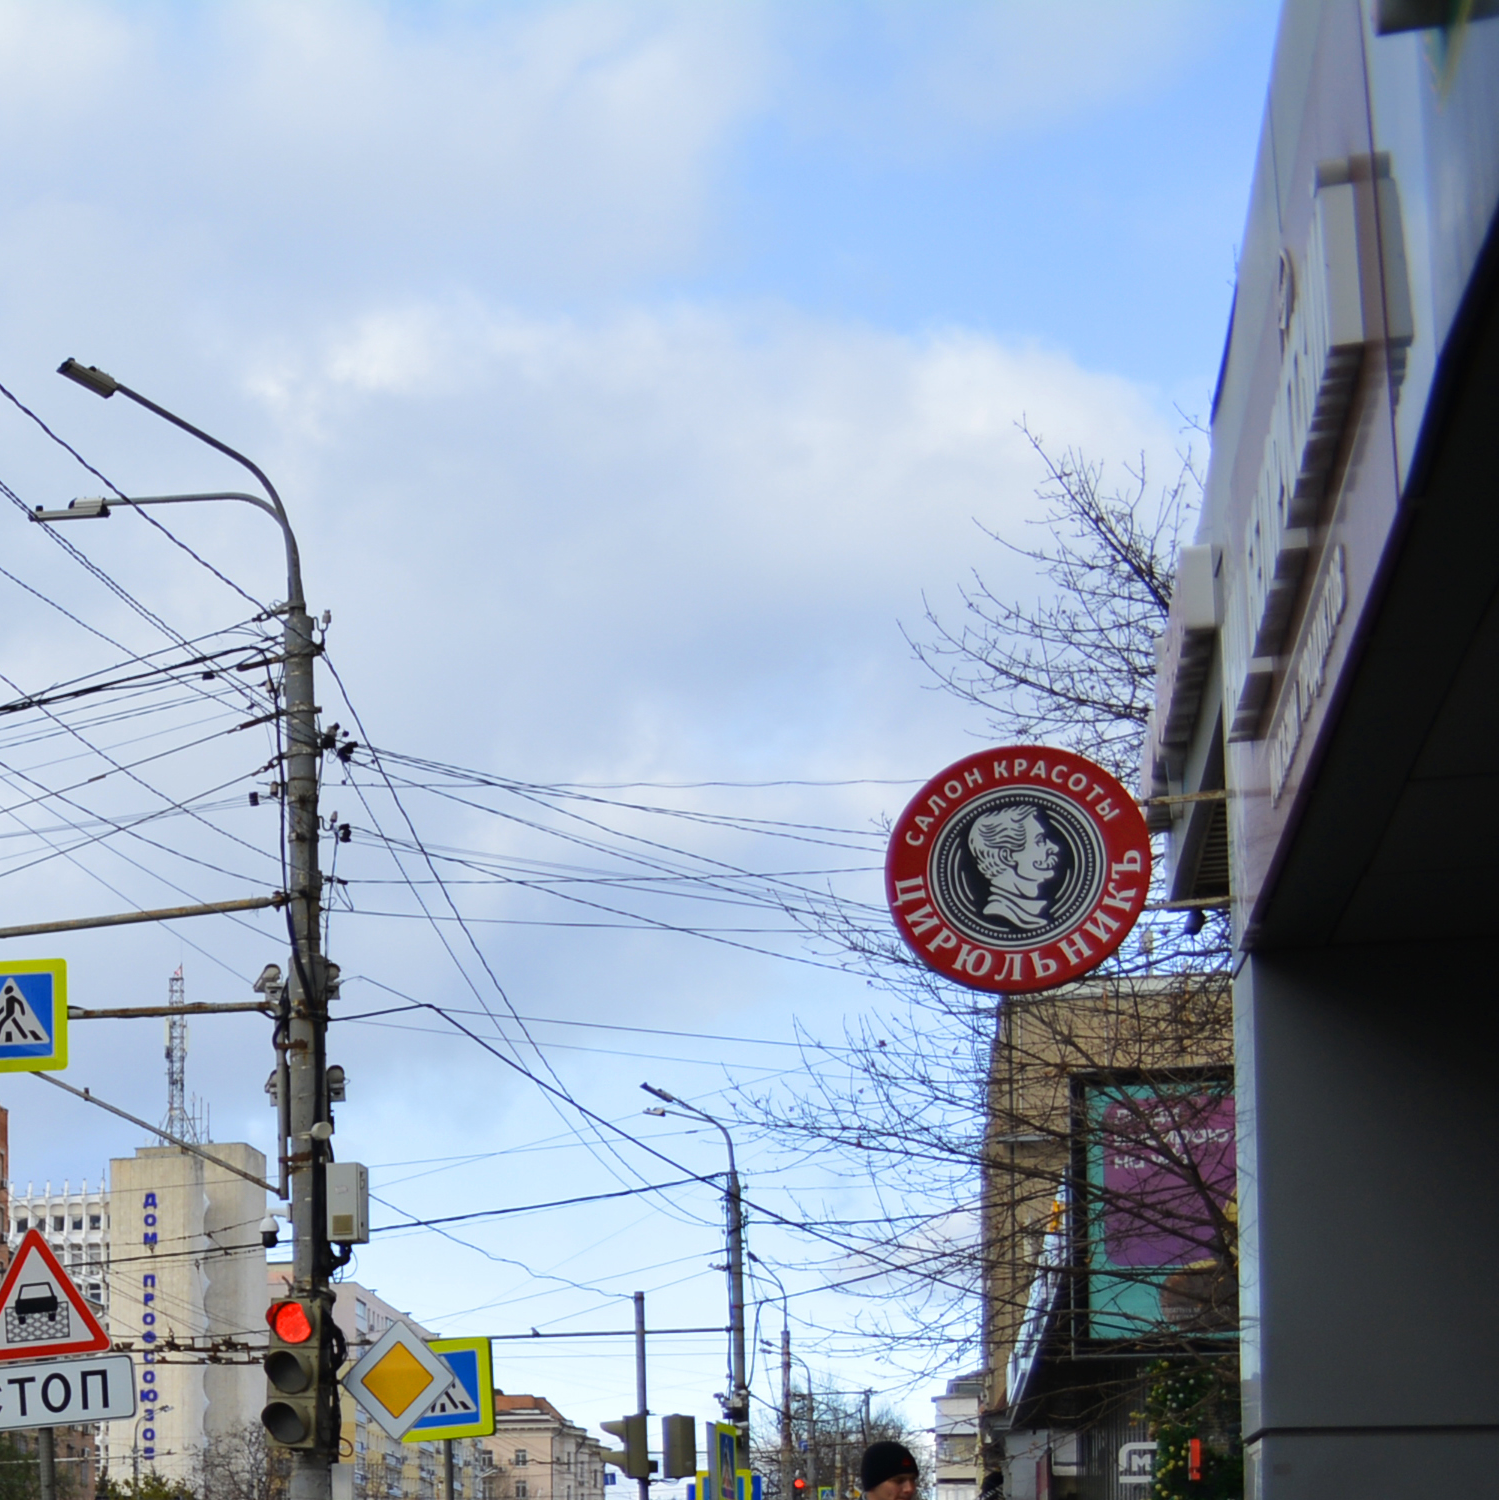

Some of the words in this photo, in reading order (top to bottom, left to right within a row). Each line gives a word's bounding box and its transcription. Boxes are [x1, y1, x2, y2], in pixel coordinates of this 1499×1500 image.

[905, 767, 984, 846] САЛОН
[993, 758, 1120, 822] КРАСОТЫ
[892, 849, 1141, 981] ЦИРЮЛЬНИКЪ
[143, 1192, 157, 1246] ДОМ
[140, 1274, 158, 1461] ПРОФСОЮЗОВ
